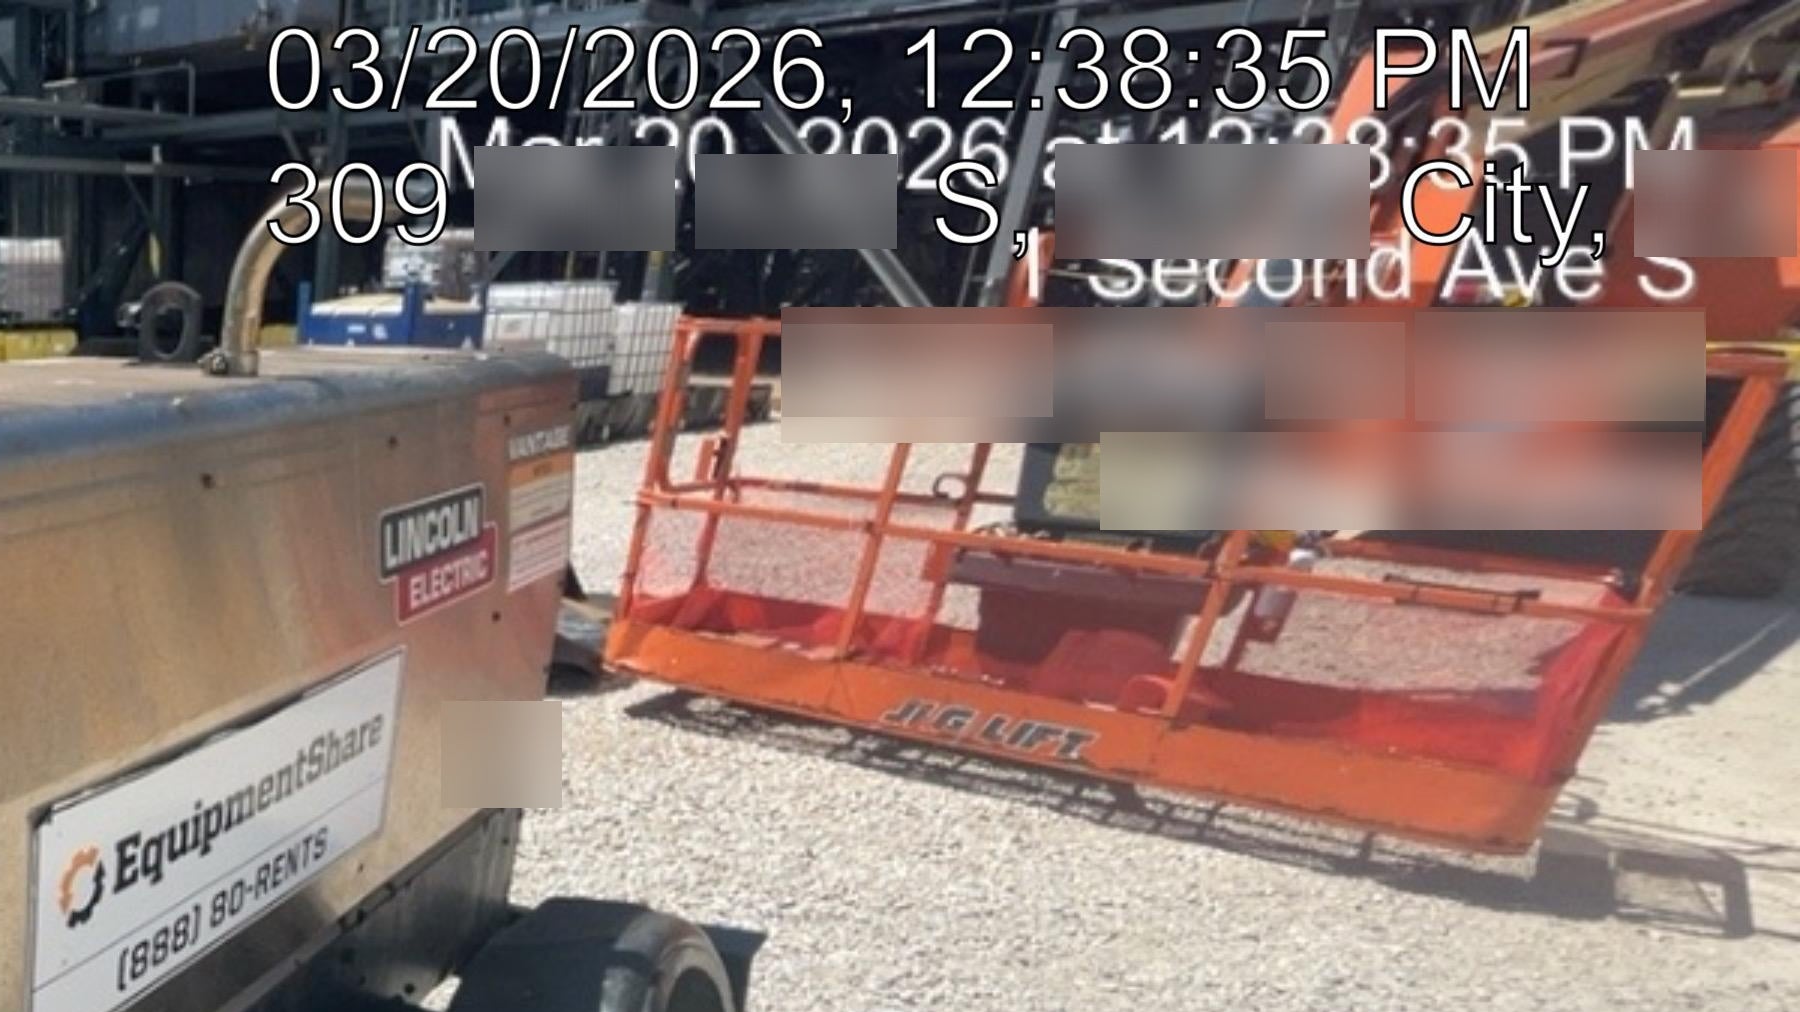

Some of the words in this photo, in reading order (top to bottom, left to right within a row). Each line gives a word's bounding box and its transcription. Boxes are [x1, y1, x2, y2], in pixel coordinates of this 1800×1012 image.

[385, 497, 482, 570] LINCOLN
[410, 550, 490, 611] ELECTRIC
[980, 713, 1099, 759] LIFT
[113, 713, 385, 893] EquipmentShare
[117, 906, 202, 991] (888)
[209, 826, 330, 930] 80-RENTS
